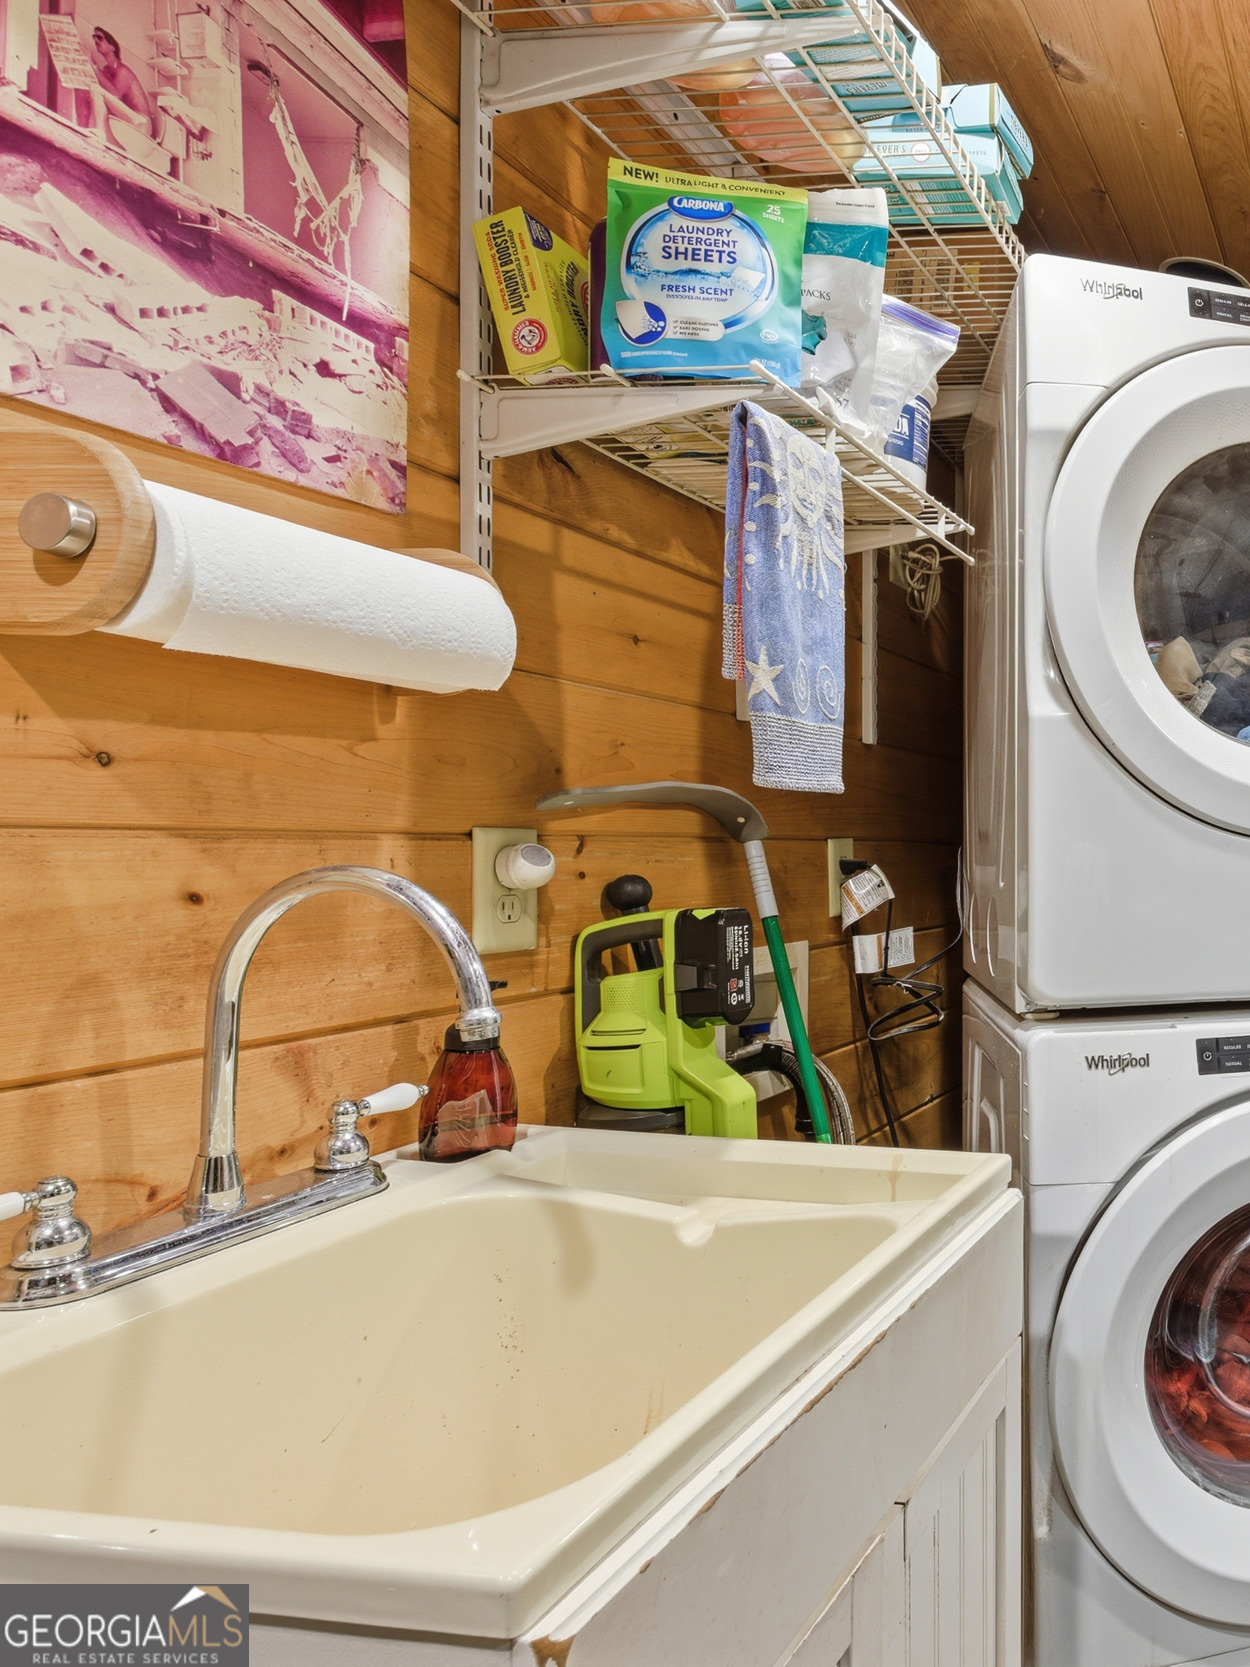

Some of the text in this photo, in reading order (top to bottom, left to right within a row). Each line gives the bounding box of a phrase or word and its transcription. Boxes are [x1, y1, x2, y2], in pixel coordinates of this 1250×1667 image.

[623, 165, 659, 183] NEW!
[729, 184, 786, 196] CONVENIENT
[673, 196, 726, 212] CARBONA
[766, 204, 781, 215] 25
[669, 223, 733, 238] LAUNDRY
[662, 234, 739, 249] DETERGENT
[661, 245, 738, 265] SHEETS
[489, 219, 527, 316] LAUNDRY BOOSTER
[660, 284, 734, 297] FRESH SCENT
[800, 289, 832, 301] PACKS
[1080, 278, 1143, 301] Whirlpool
[1084, 1052, 1150, 1076] Whirlpool
